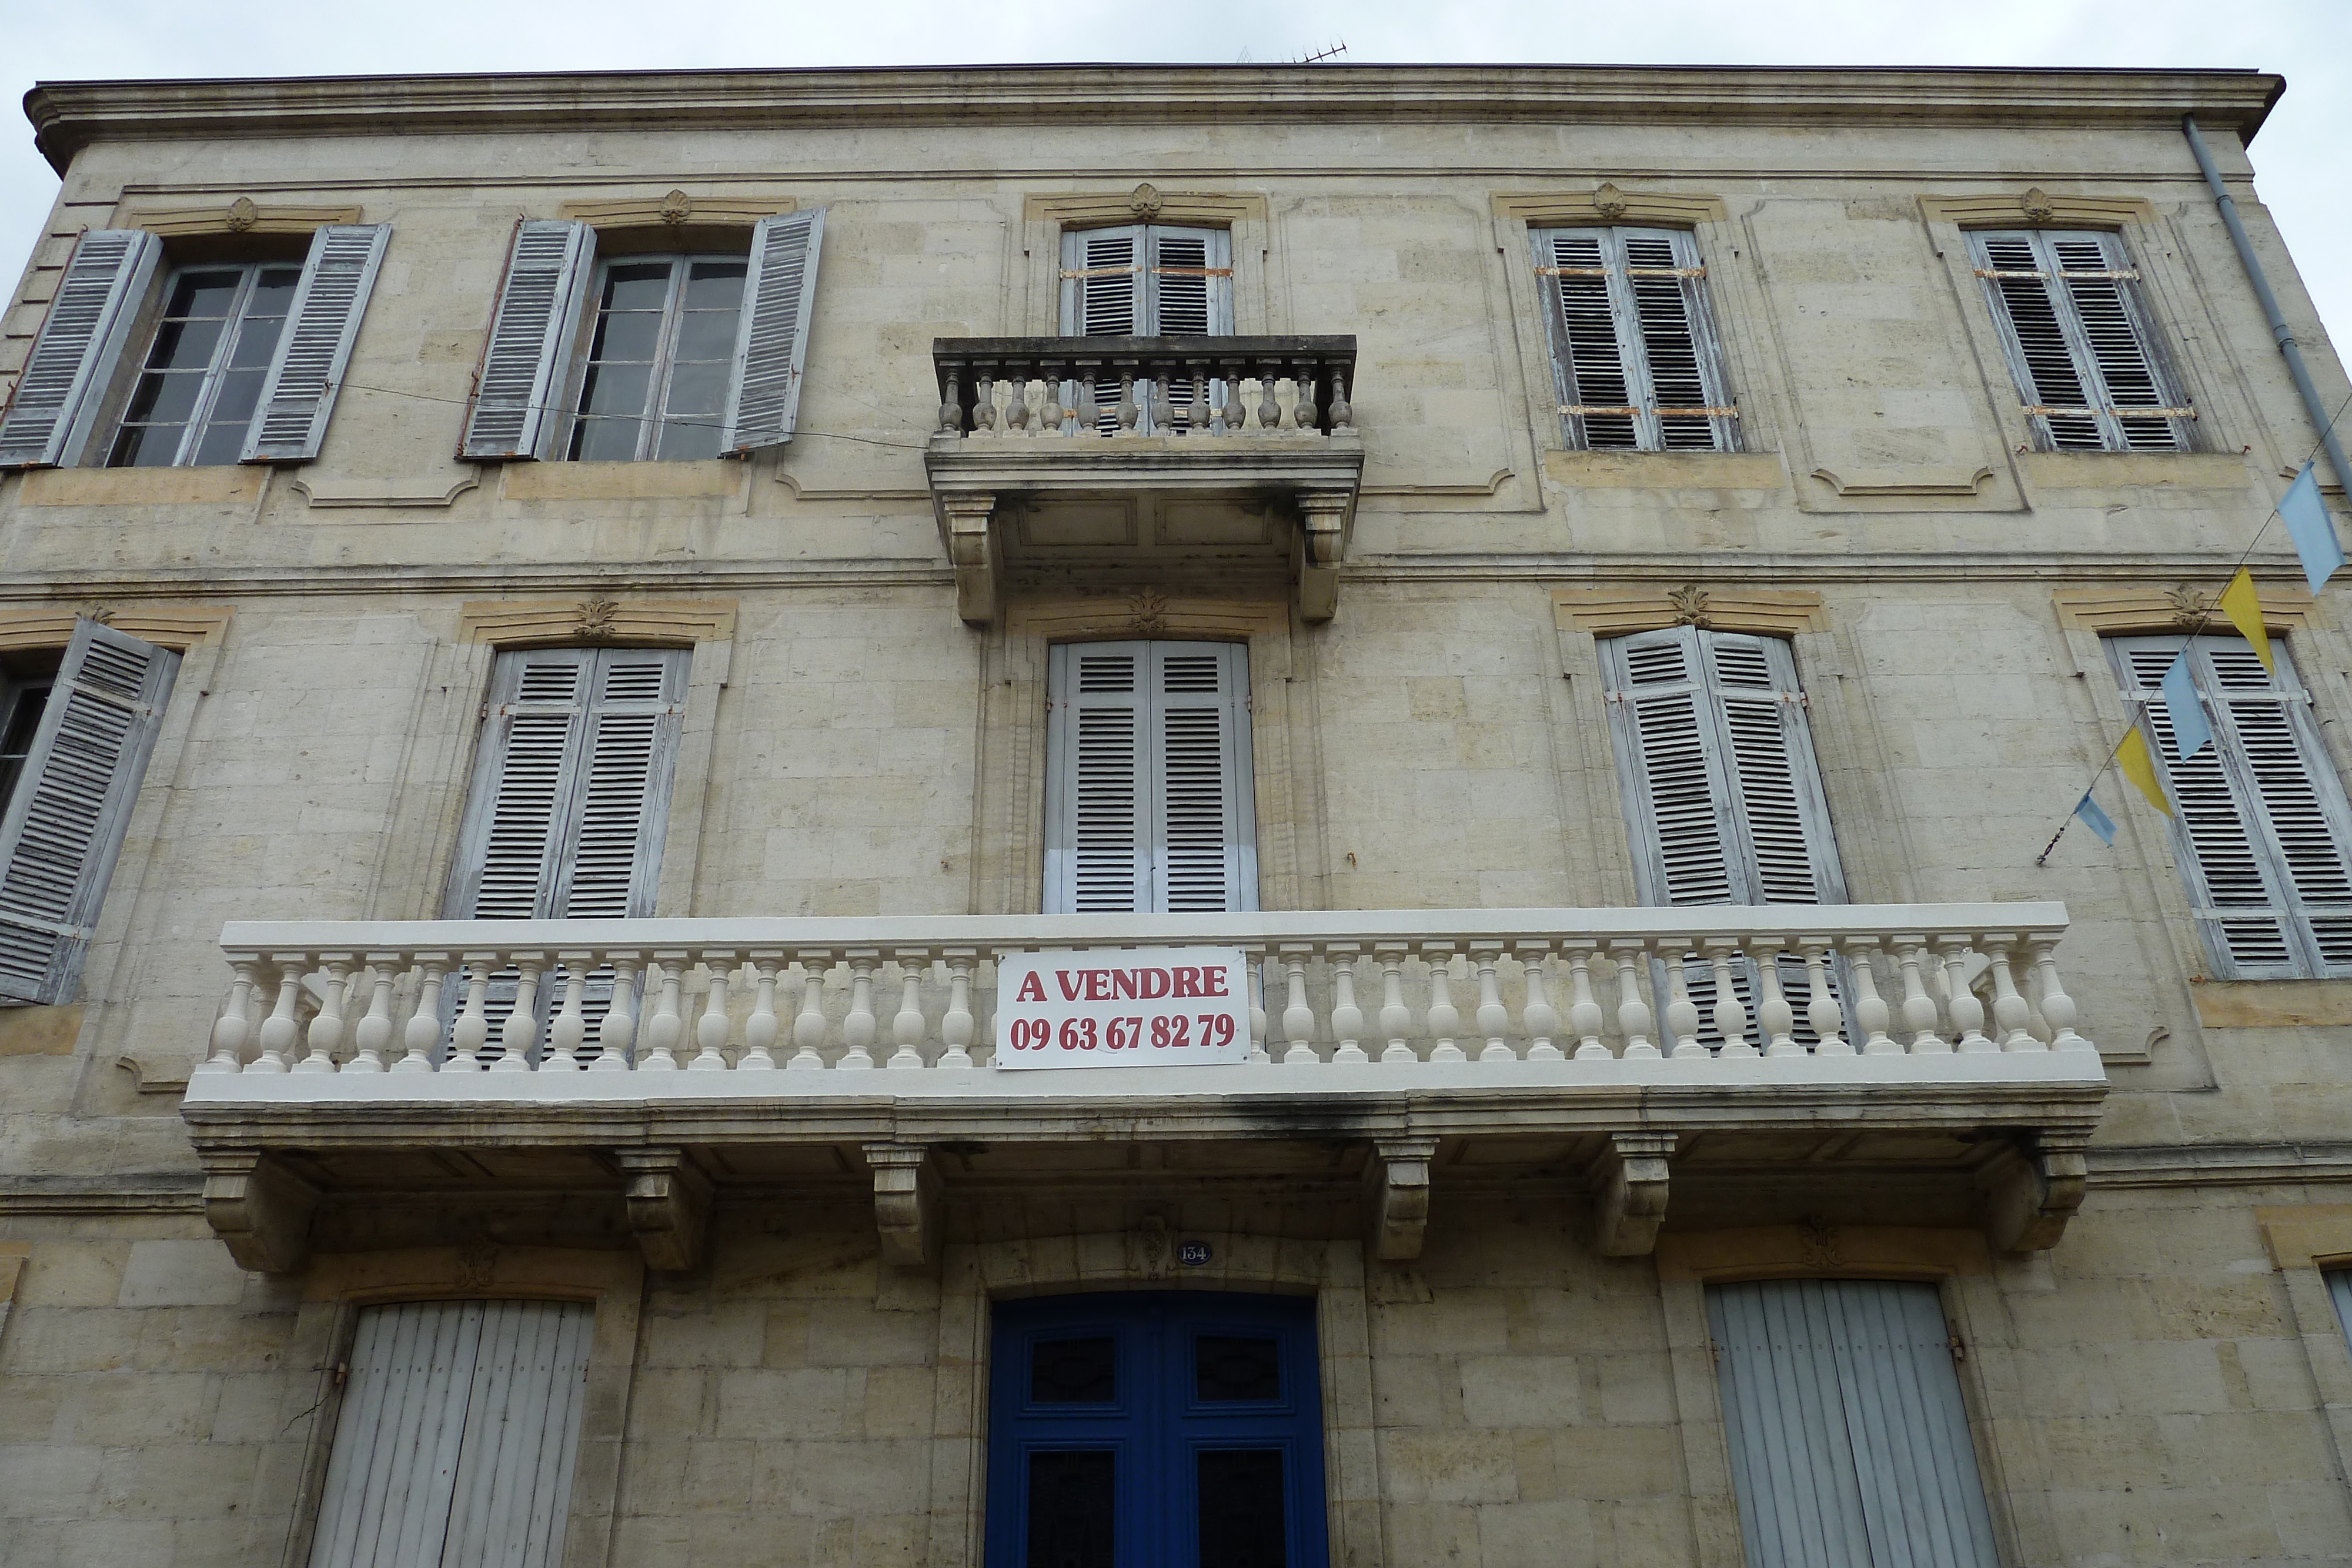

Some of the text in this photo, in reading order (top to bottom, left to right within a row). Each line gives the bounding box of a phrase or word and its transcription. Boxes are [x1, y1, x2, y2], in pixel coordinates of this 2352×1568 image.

[1016, 966, 1230, 1002] A VENDRE
[1010, 1014, 1235, 1051] 09 63 67 82 79
[1182, 1246, 1206, 1259] 134
